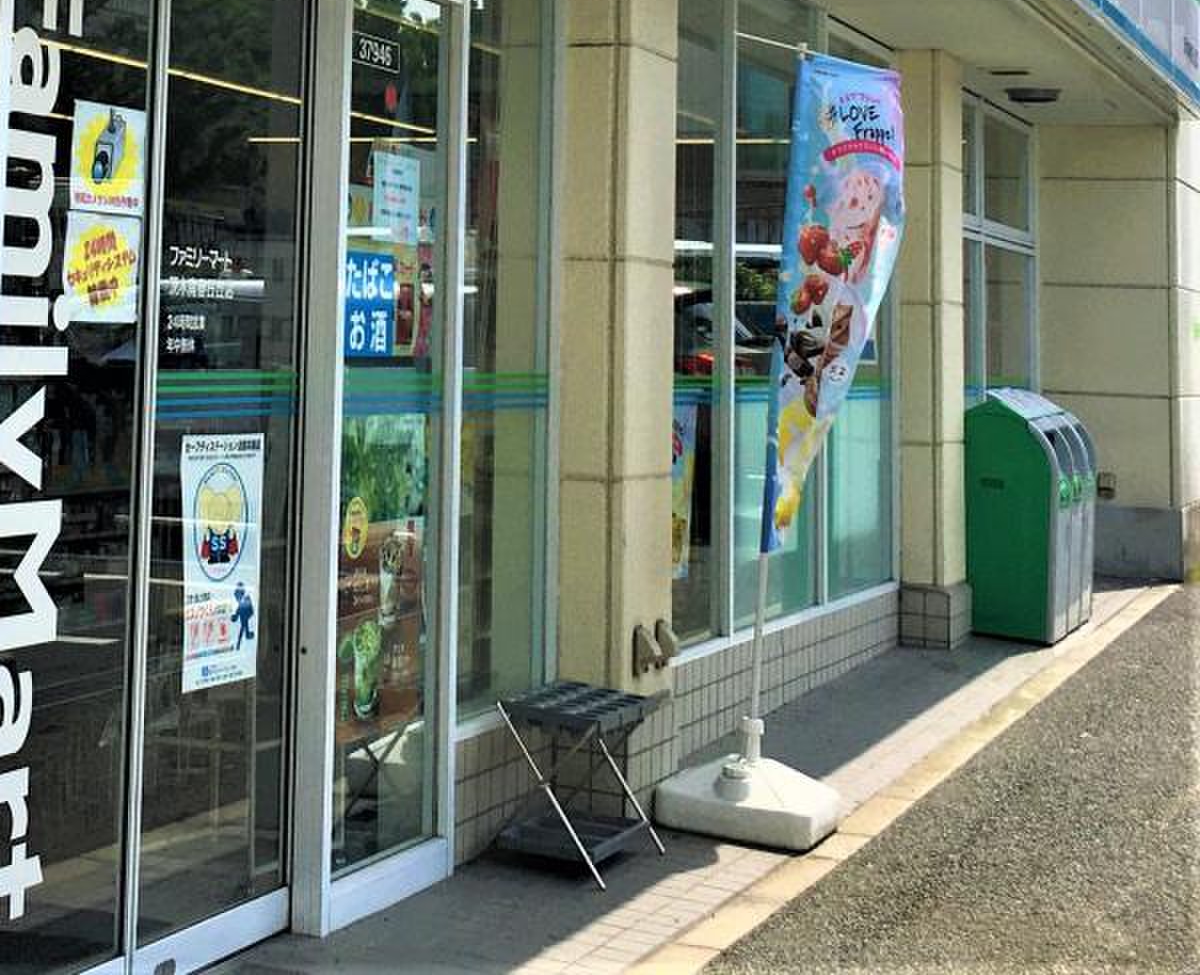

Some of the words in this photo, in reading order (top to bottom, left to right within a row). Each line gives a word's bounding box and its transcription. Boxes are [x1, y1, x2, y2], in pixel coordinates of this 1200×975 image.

[358, 37, 393, 66] 37946
[169, 245, 233, 273] ファミリーマート
[347, 256, 395, 300] たばこ
[350, 309, 388, 353] お酒
